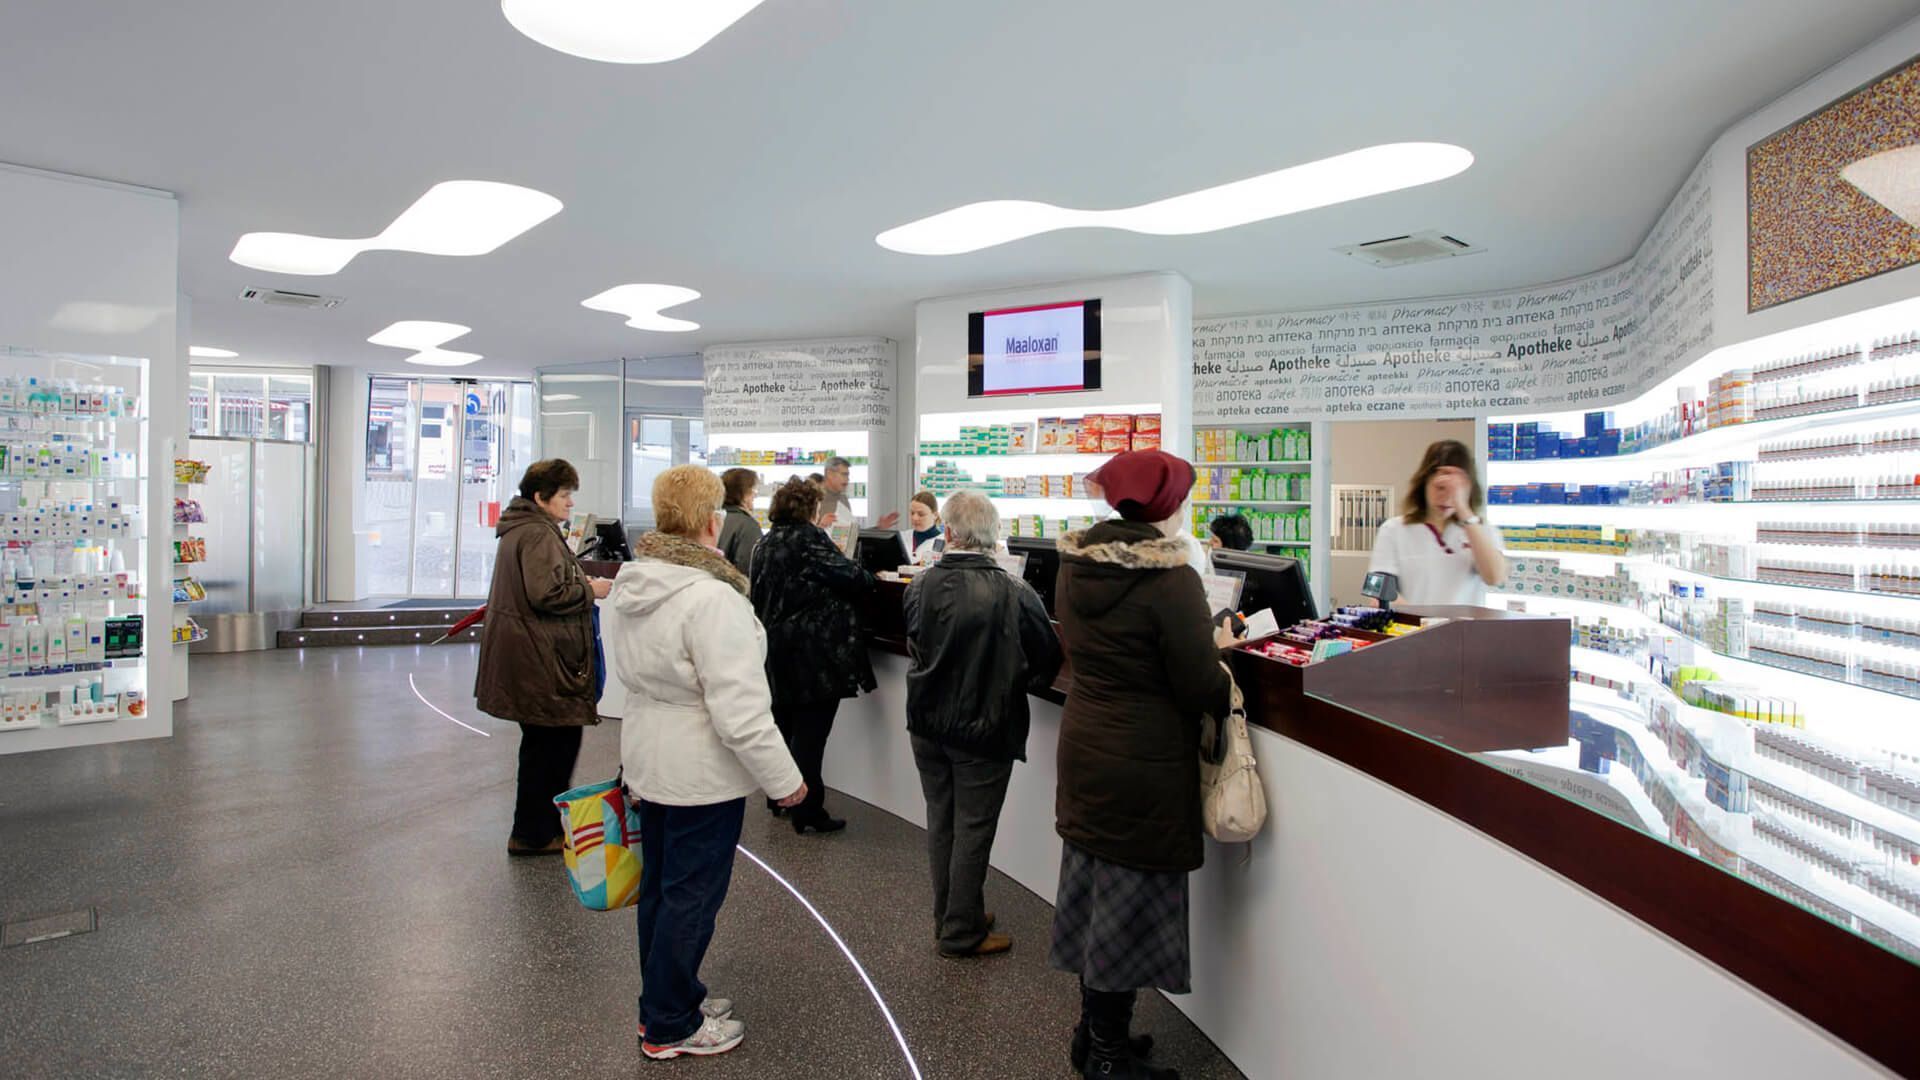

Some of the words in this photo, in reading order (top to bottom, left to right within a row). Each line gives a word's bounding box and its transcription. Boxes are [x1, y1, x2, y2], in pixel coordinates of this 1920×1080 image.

[1192, 323, 1227, 333] rmacy
[1278, 314, 1336, 329] pharmacy
[1392, 304, 1457, 321] pharmacy
[1517, 288, 1577, 309] pharmacy
[1211, 335, 1244, 347] מרקחת
[1247, 335, 1264, 344] בית
[1268, 331, 1312, 343] аптека
[1319, 327, 1355, 340] מרקחת
[1359, 325, 1377, 336] בית
[1382, 322, 1431, 335] аптека
[1438, 319, 1478, 332] מרקחת
[1482, 317, 1502, 328] בית
[1506, 310, 1555, 326] аптека
[1560, 300, 1593, 318] מרקחת
[1006, 335, 1058, 355] Maaloxan
[1193, 361, 1222, 375] heke
[1269, 355, 1331, 374] Apotheke
[1382, 348, 1450, 369] Apotheke
[1507, 336, 1573, 361] Apotheke
[1204, 349, 1245, 360] farmacia
[1311, 342, 1357, 354] farmacia
[1430, 335, 1480, 347] farmacia
[1553, 318, 1595, 336] farmacia
[743, 381, 786, 396] Apotheke
[820, 378, 866, 394] Apotheke
[1417, 367, 1484, 380] pharmacie
[1217, 405, 1250, 417] apteka
[1254, 405, 1289, 415] eczane
[1326, 401, 1362, 414] apteka
[1367, 401, 1405, 411] eczane
[1446, 396, 1486, 411] apteka
[1490, 395, 1530, 407] eczane
[1567, 386, 1599, 403] apteka
